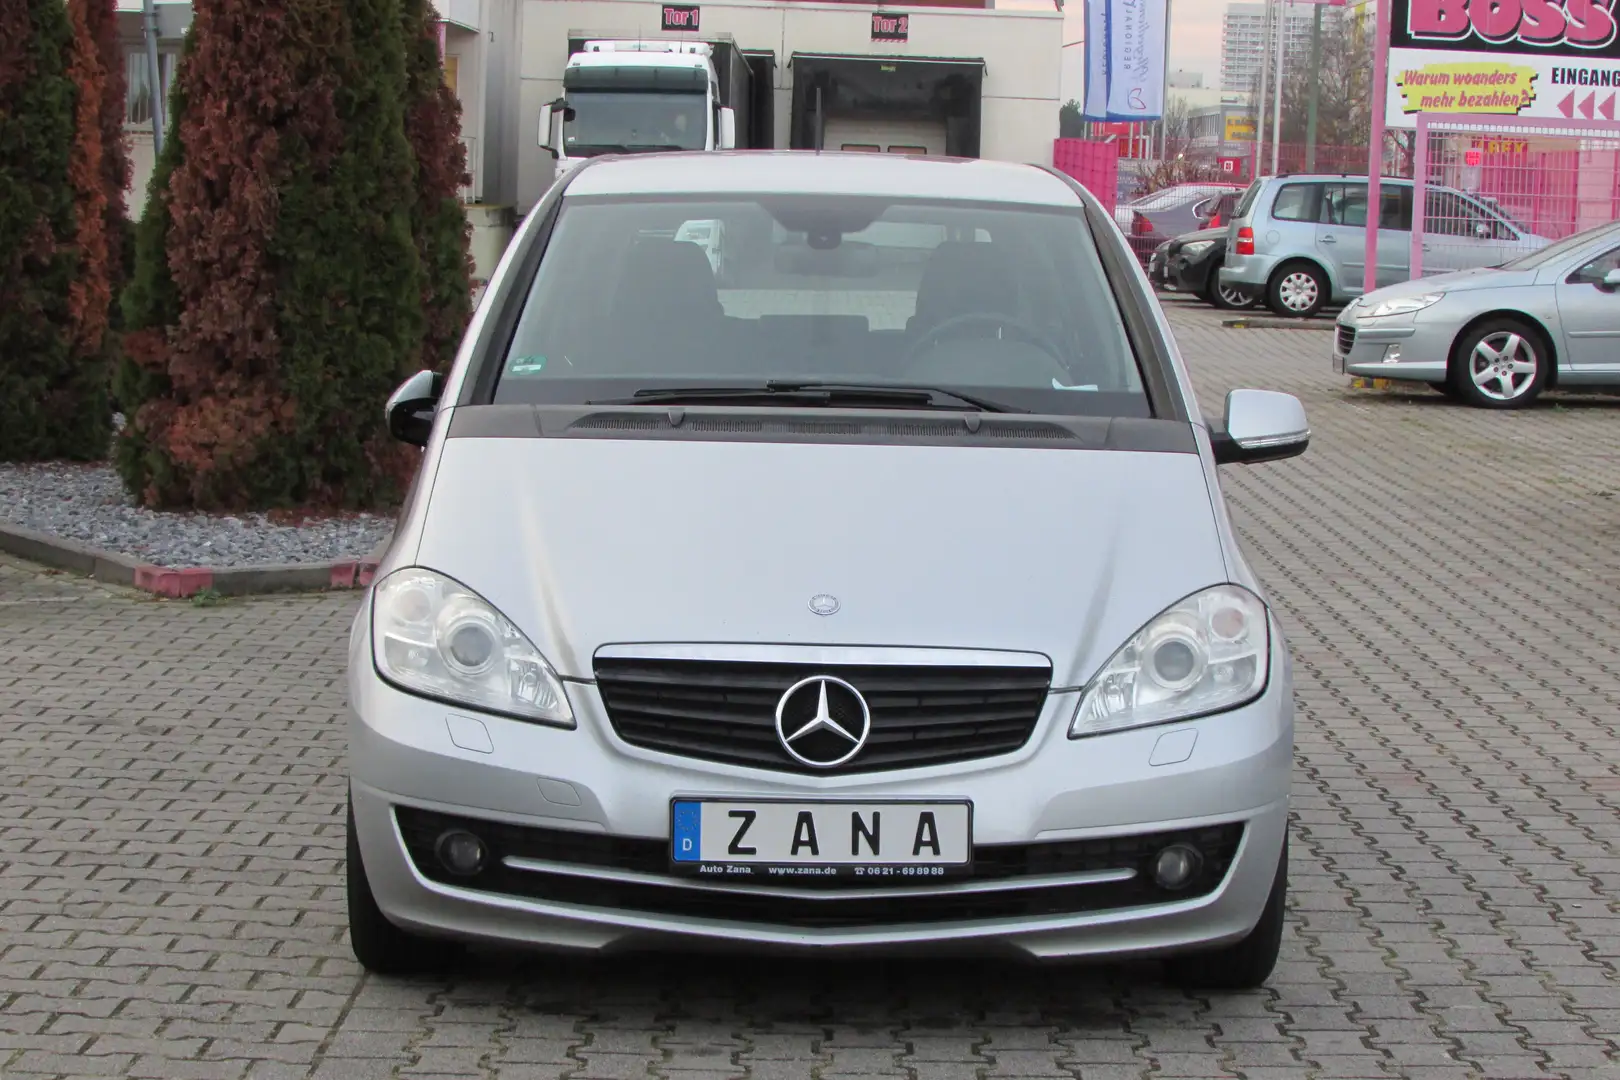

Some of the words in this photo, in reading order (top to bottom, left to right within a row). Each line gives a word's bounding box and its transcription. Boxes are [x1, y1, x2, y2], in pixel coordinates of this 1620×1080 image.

[664, 8, 689, 26] Tor
[690, 9, 699, 26] 1
[872, 16, 897, 33] Tor
[898, 17, 908, 34] 2
[1404, 70, 1450, 86] Warum
[1453, 70, 1517, 86] woanders
[1420, 91, 1458, 108] mehr
[1457, 89, 1529, 108] bezahlen?
[728, 810, 941, 856] ZANA
[682, 838, 692, 851] D
[700, 865, 723, 873] Auto
[726, 865, 751, 873] Zana
[768, 866, 837, 875] www.zana.de
